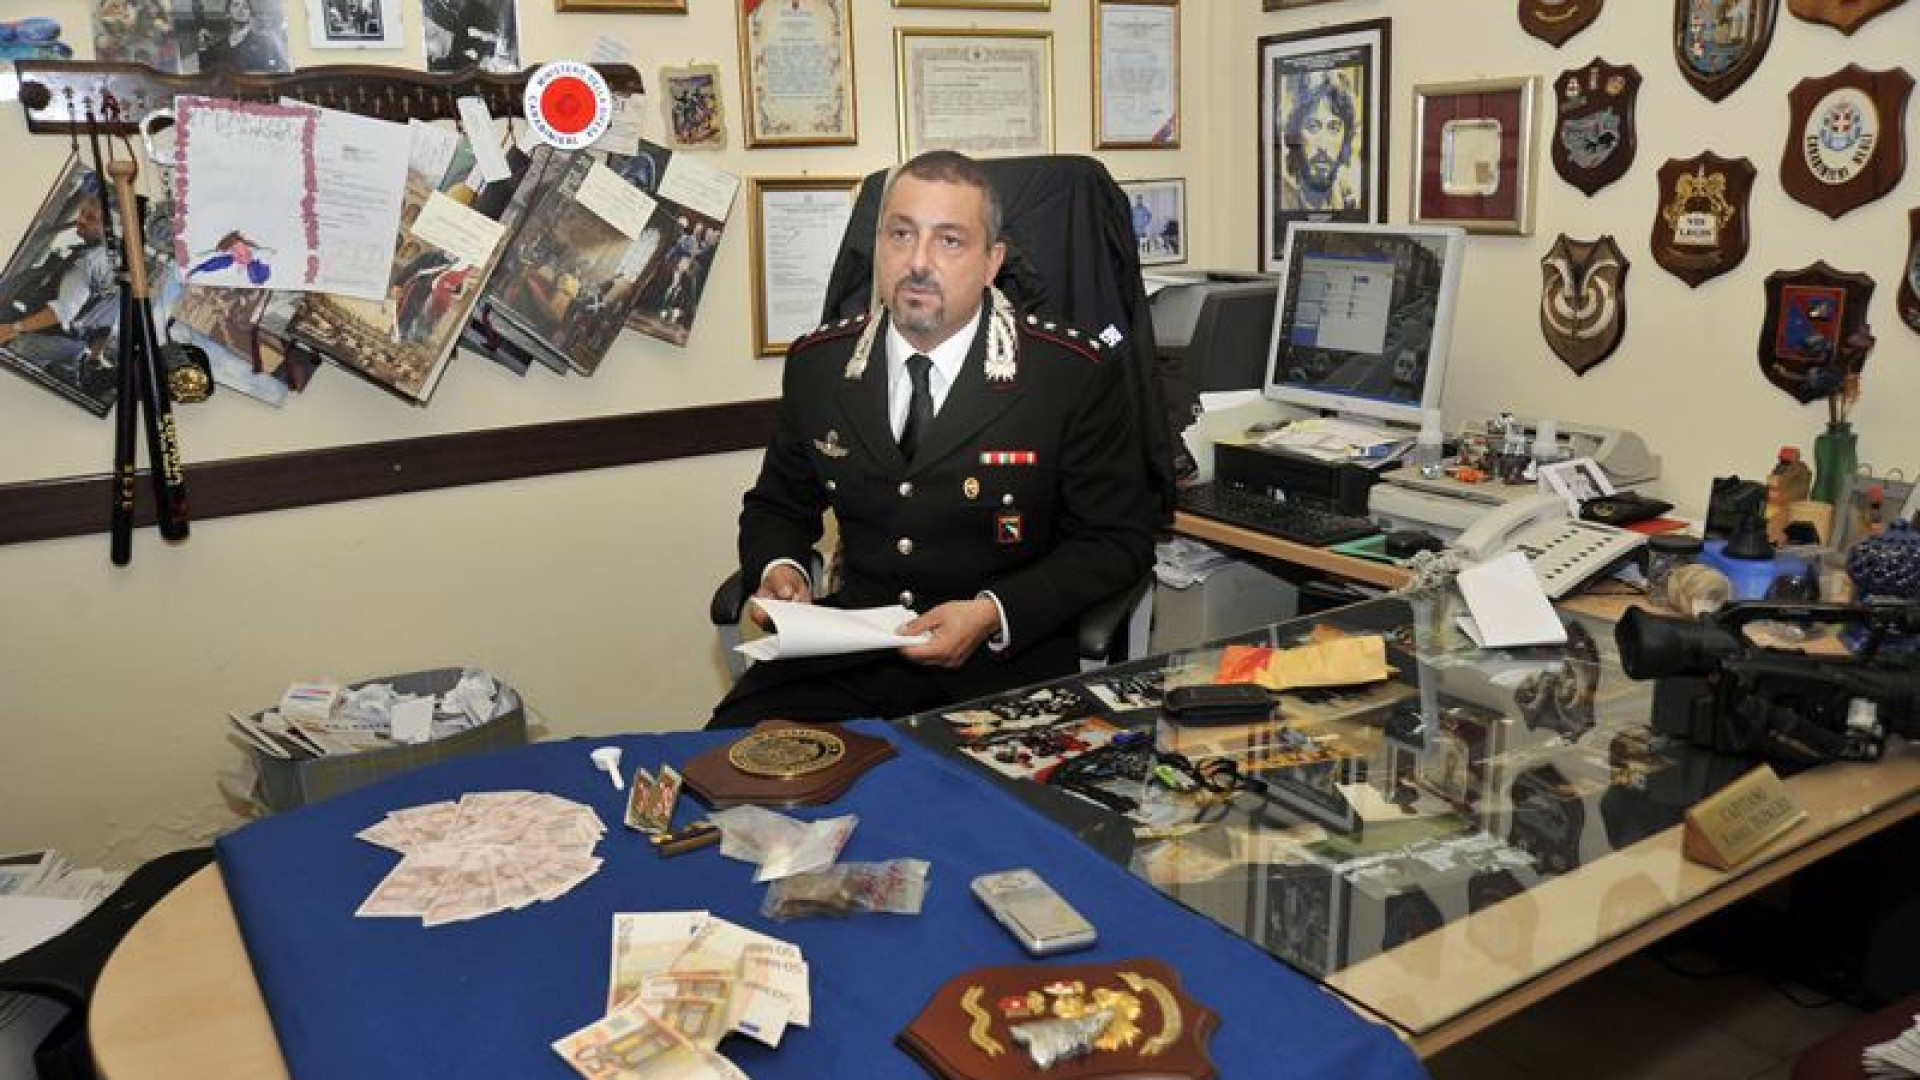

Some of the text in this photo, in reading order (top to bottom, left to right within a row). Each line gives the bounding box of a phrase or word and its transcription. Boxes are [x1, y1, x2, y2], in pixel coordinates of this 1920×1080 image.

[536, 64, 588, 87] MINISTERO
[586, 72, 607, 103] DELLA
[528, 95, 578, 145] CARABINIERI
[1807, 133, 1873, 180] CARABINIERI REALI
